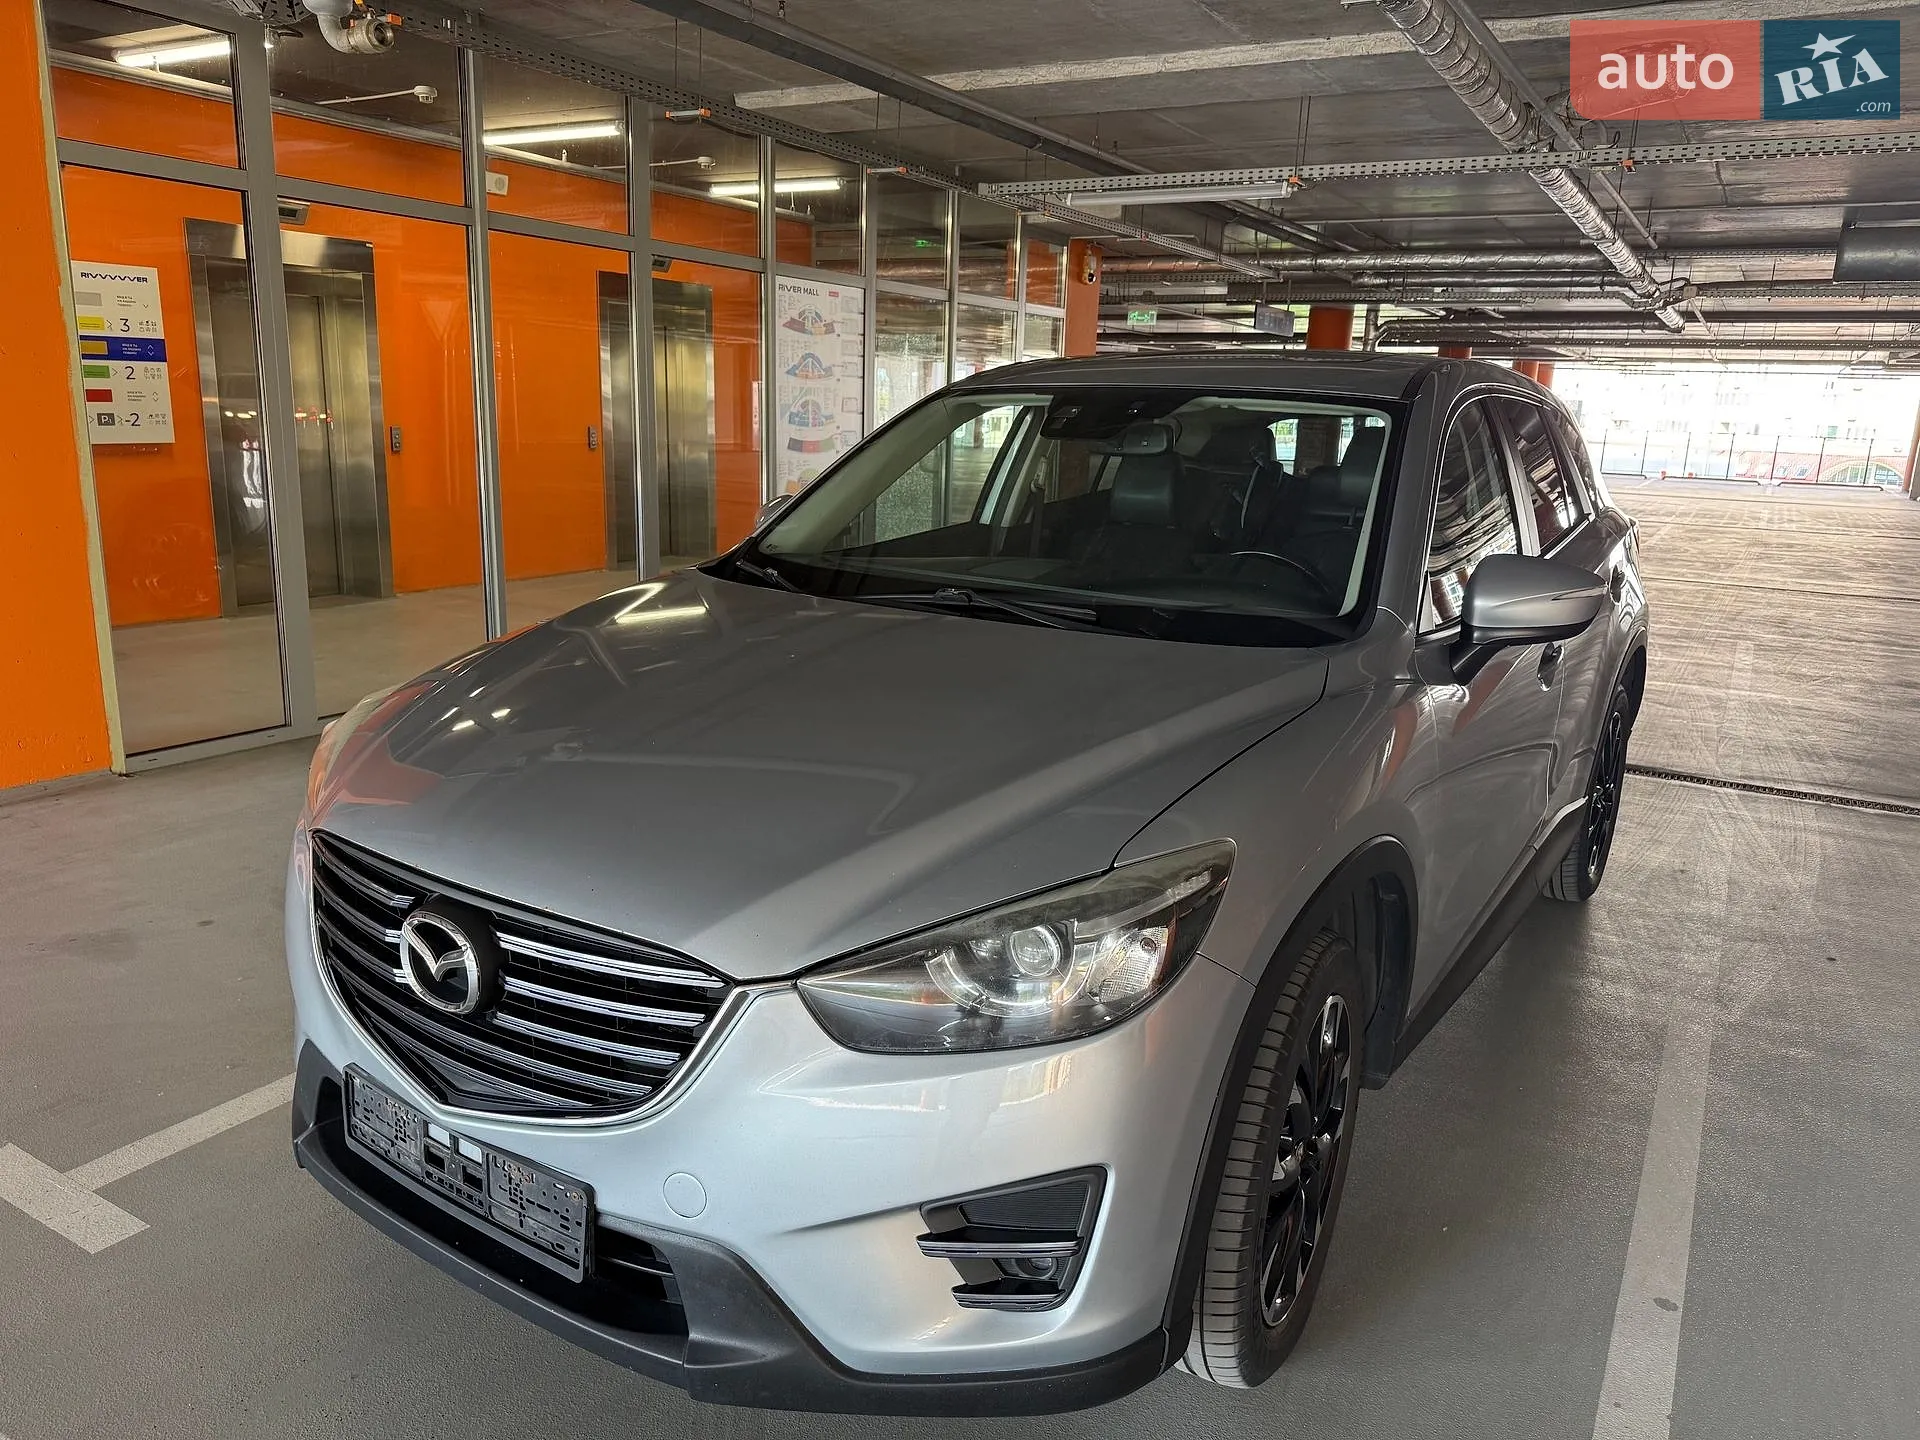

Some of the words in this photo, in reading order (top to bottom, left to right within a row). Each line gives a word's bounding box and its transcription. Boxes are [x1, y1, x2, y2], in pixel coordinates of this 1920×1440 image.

[778, 284, 802, 294] RIVER
[803, 287, 820, 296] MALL
[119, 318, 130, 332] 3
[124, 366, 136, 380] 2
[125, 412, 141, 426] -2
